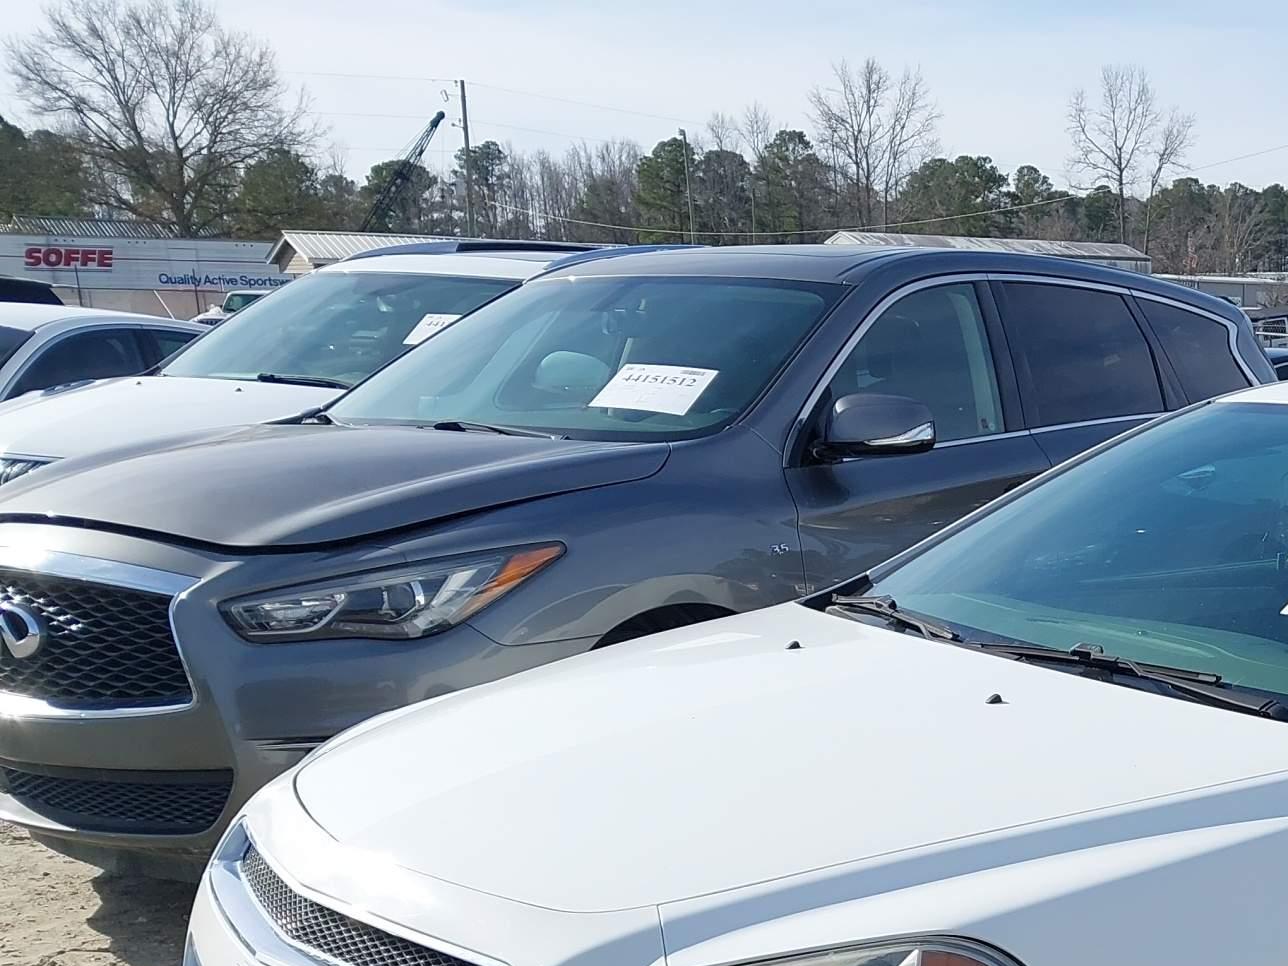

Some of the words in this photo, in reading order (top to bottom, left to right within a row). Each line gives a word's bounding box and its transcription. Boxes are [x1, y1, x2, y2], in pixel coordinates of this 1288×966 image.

[24, 247, 113, 268] SOFFE
[158, 273, 202, 287] Quality
[200, 274, 238, 286] Active
[622, 373, 697, 387] 44151512
